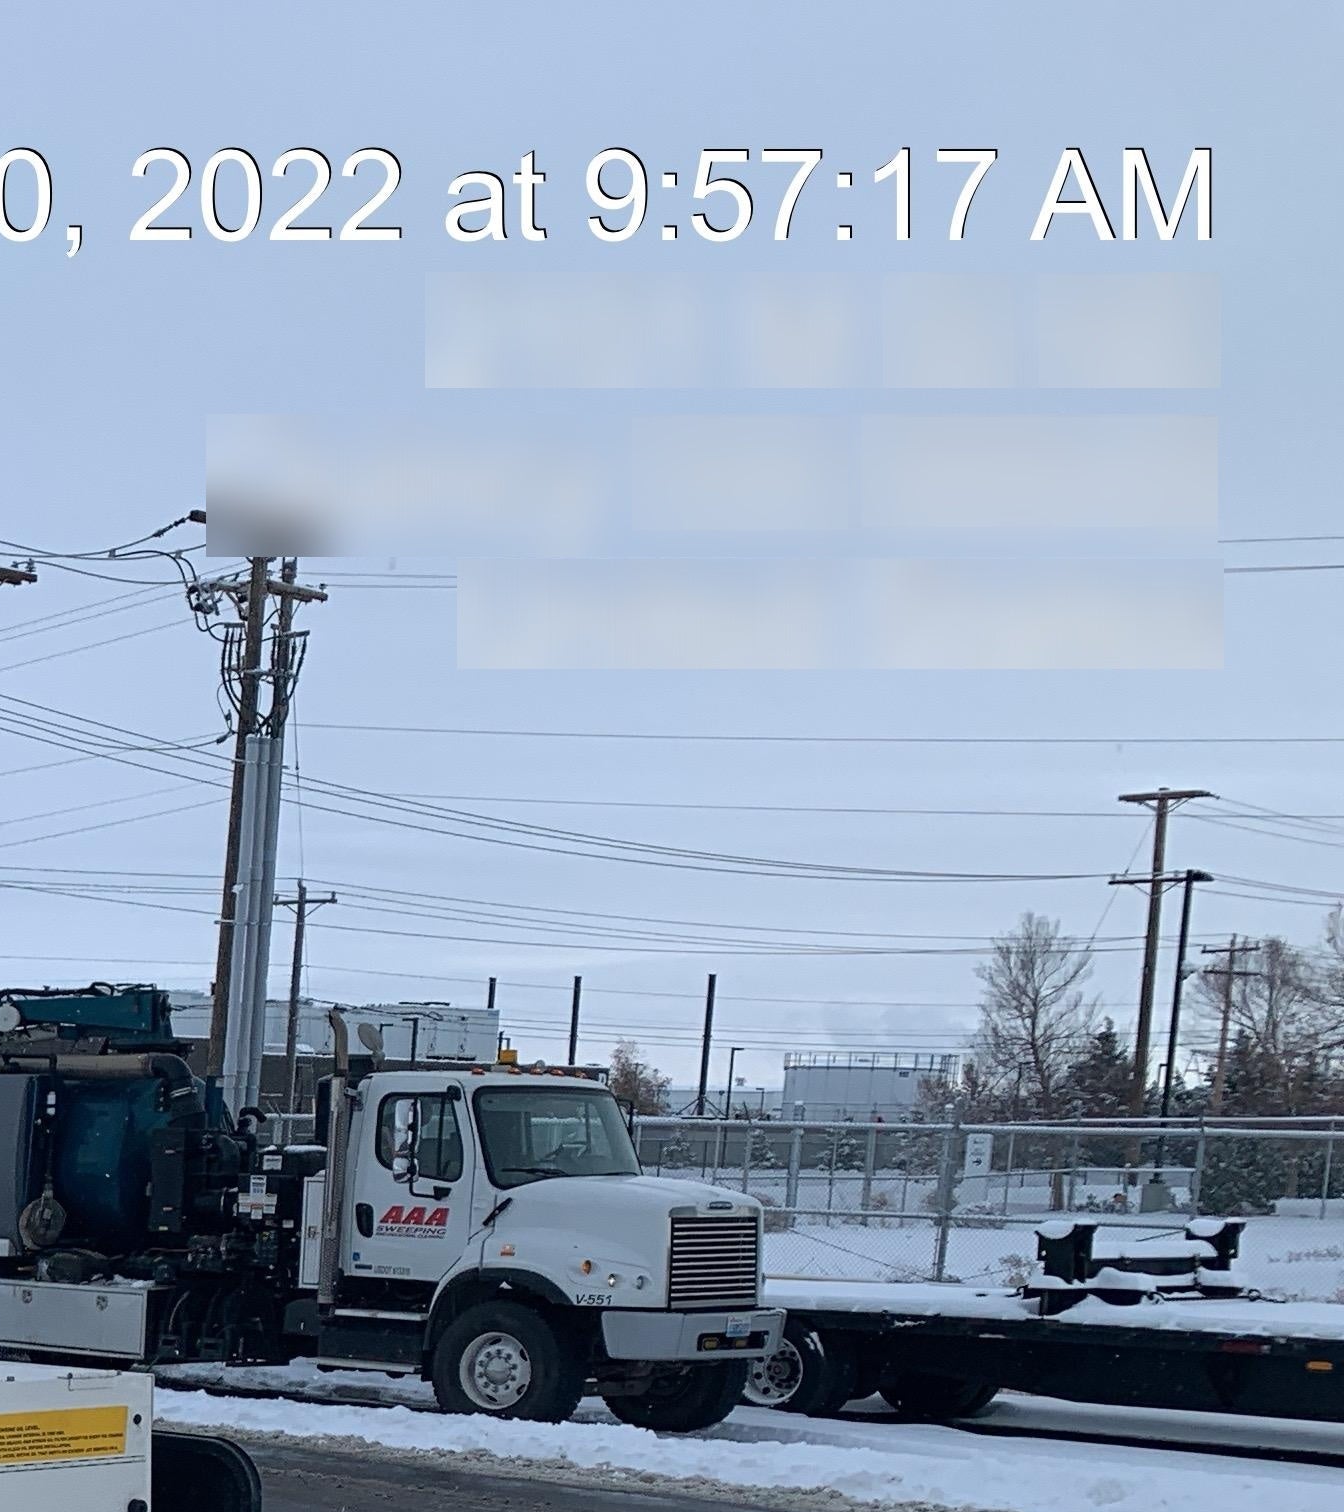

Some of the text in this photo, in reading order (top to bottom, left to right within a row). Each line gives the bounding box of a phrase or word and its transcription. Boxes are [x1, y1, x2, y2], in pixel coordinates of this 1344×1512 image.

[378, 1205, 450, 1227] AAA
[376, 1225, 447, 1235] SWEEPING
[575, 1294, 613, 1306] V-551
